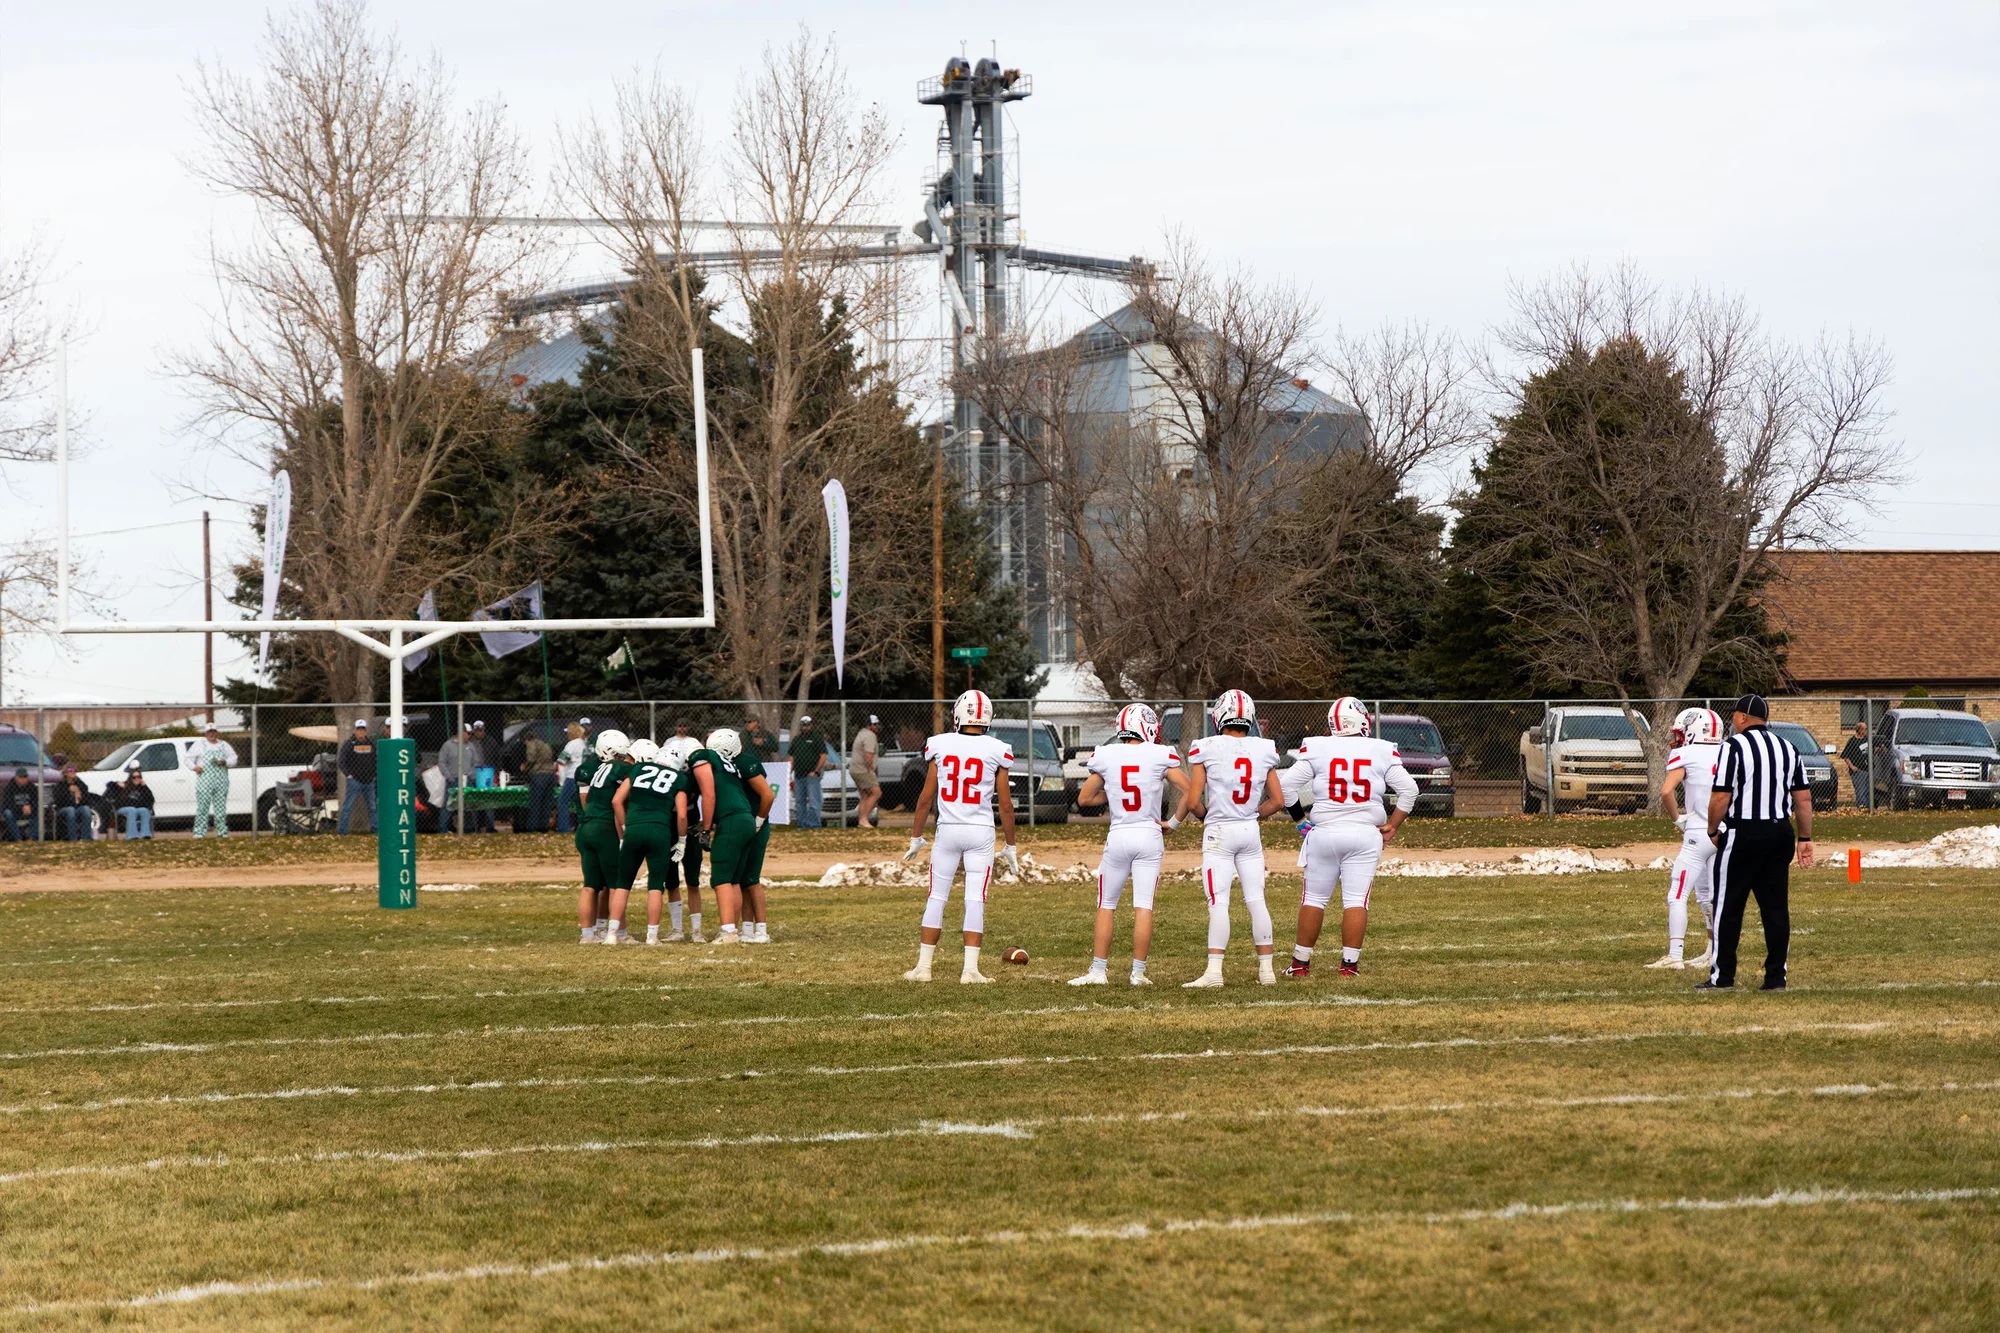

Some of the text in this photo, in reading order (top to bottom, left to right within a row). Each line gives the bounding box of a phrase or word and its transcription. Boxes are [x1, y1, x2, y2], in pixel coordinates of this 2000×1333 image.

[632, 765, 678, 794] 28
[940, 754, 984, 805] 32
[1121, 765, 1142, 812] 5
[1231, 757, 1253, 805] 3
[1328, 757, 1372, 804] 65
[397, 748, 411, 905] STRATTON
